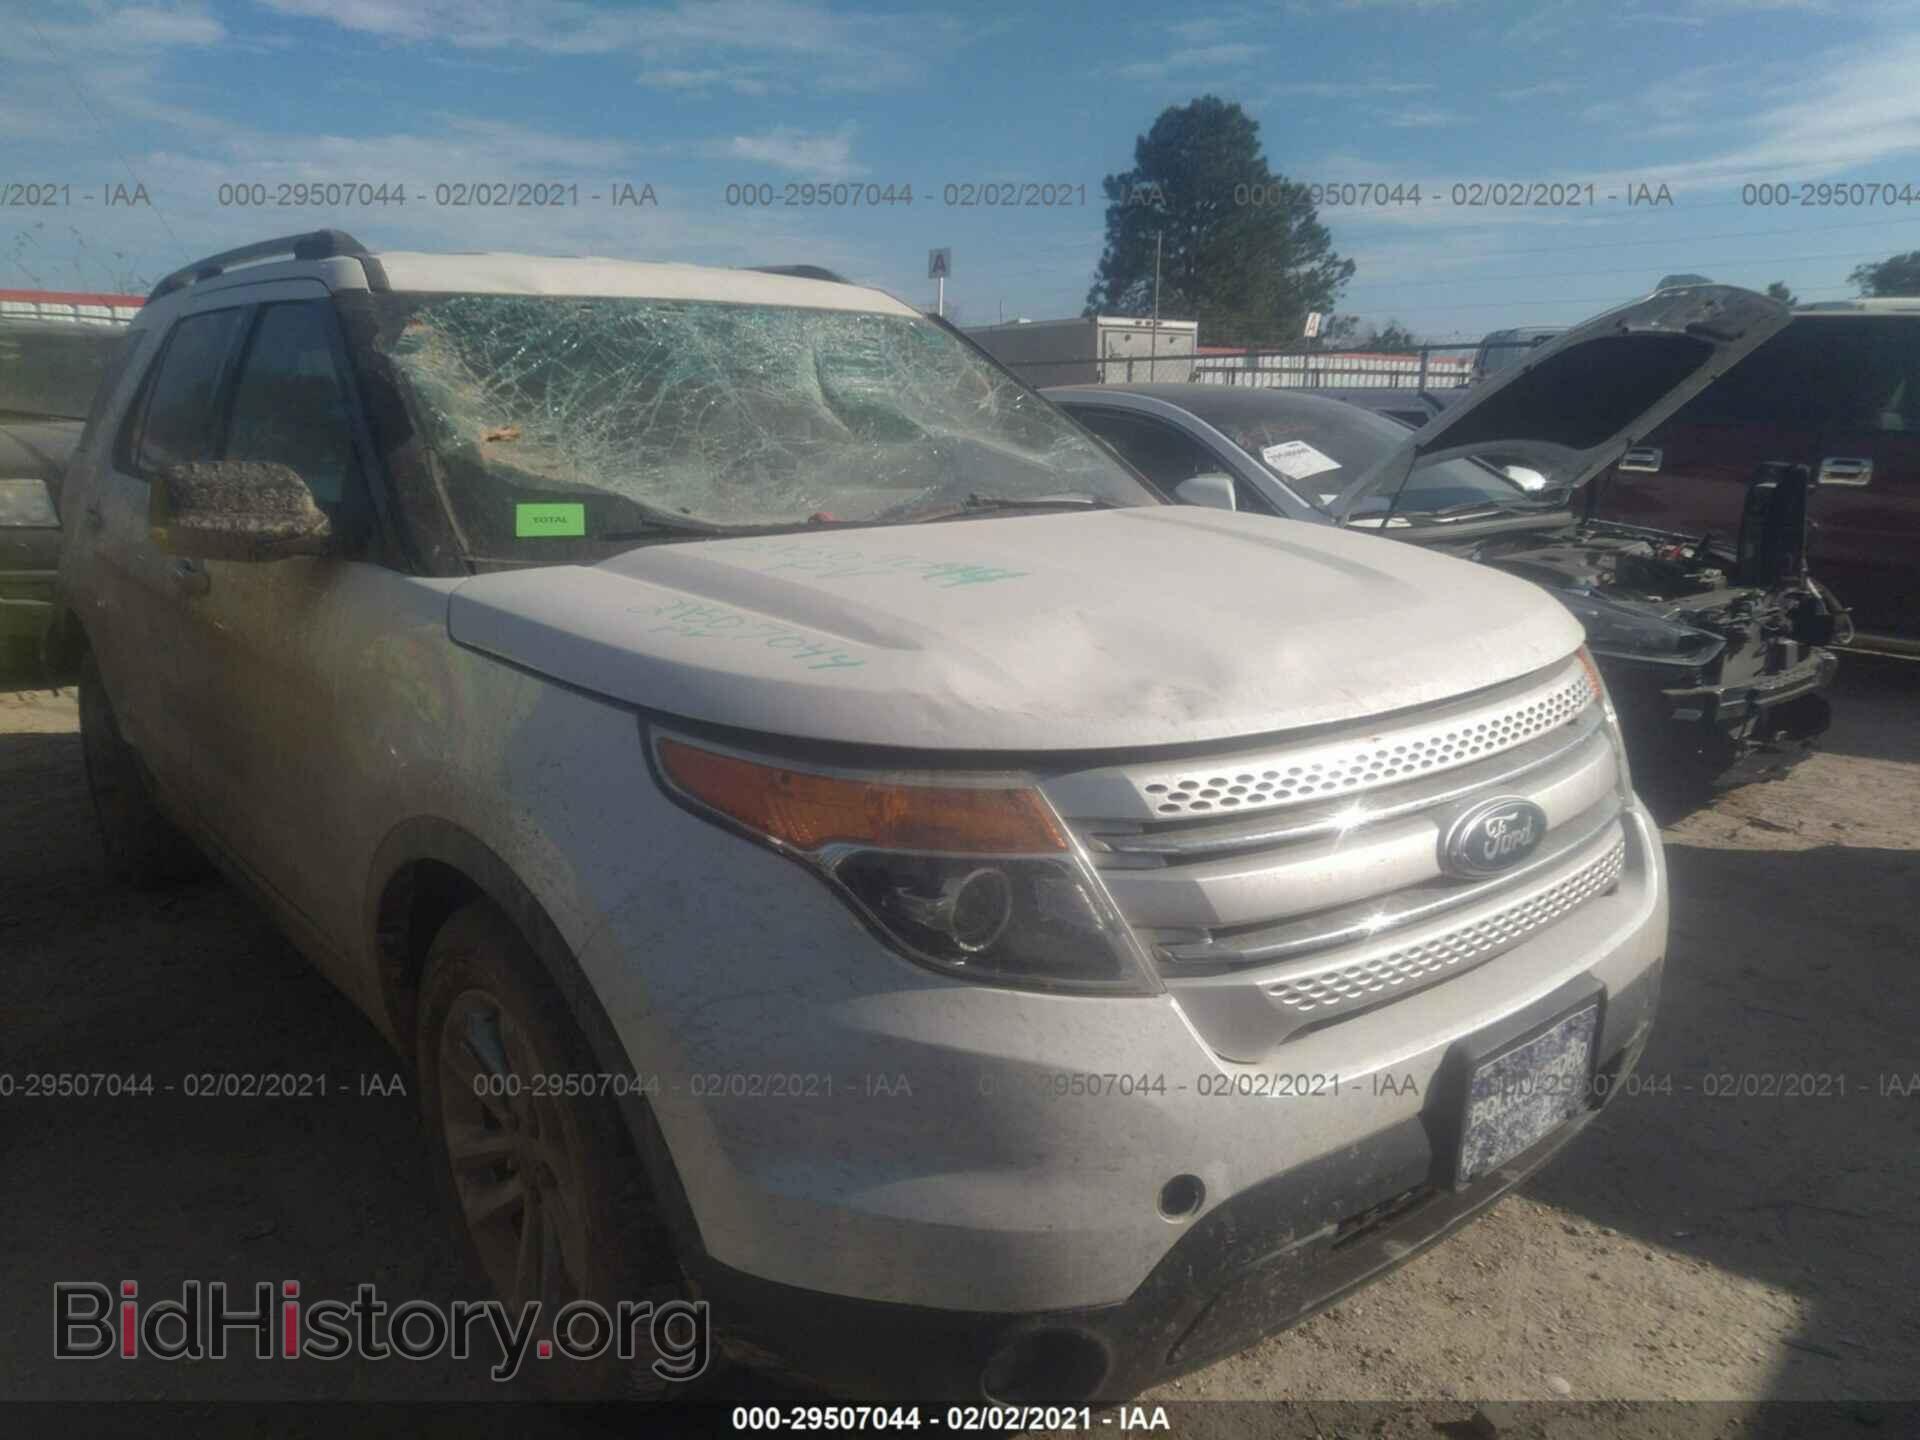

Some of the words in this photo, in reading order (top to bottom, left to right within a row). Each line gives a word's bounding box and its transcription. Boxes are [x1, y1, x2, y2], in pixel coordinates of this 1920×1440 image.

[933, 254, 947, 273] A
[533, 516, 568, 525] TOTAL
[1483, 811, 1536, 861] Ford
